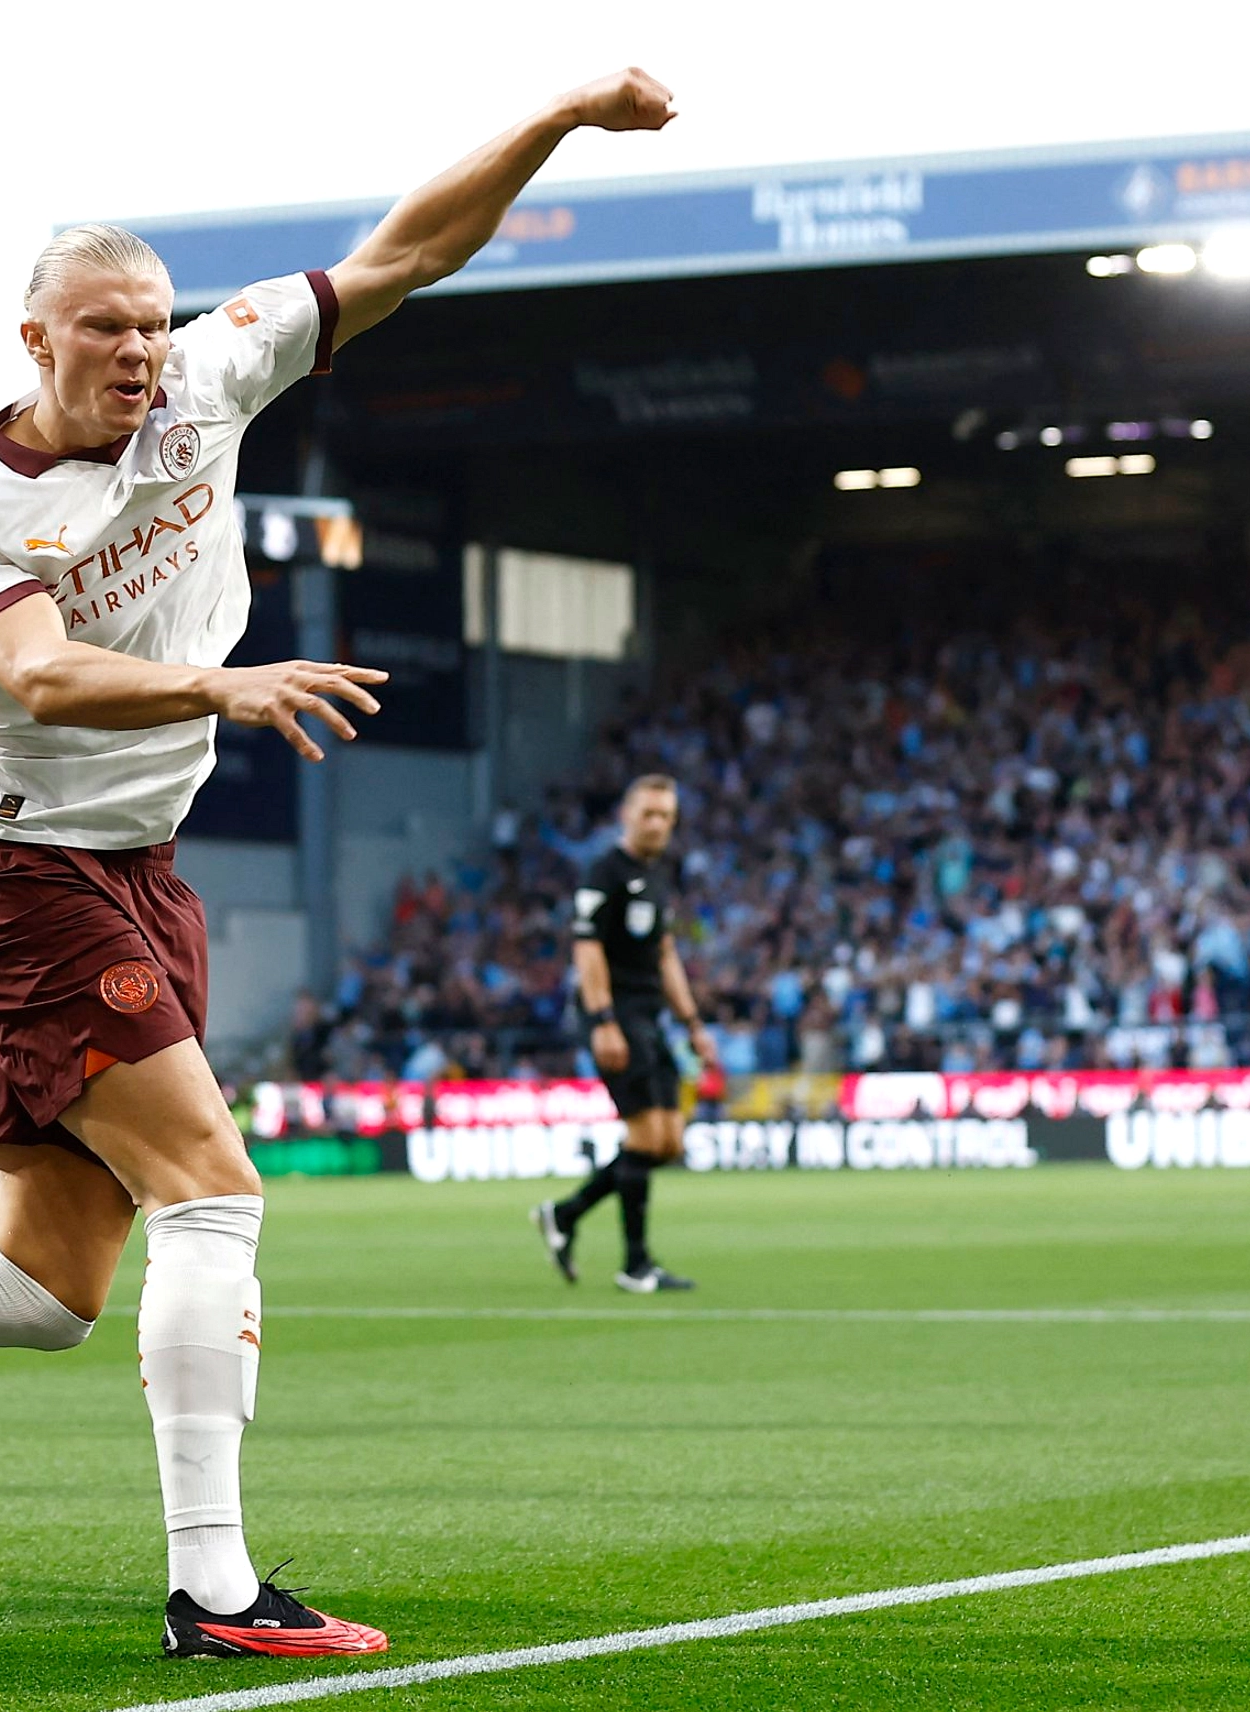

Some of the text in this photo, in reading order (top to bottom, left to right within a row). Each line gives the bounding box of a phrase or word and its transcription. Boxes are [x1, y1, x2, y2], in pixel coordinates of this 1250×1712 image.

[69, 541, 199, 629] AIRWAYS
[682, 1121, 793, 1172] STAY
[798, 1120, 844, 1170] IN
